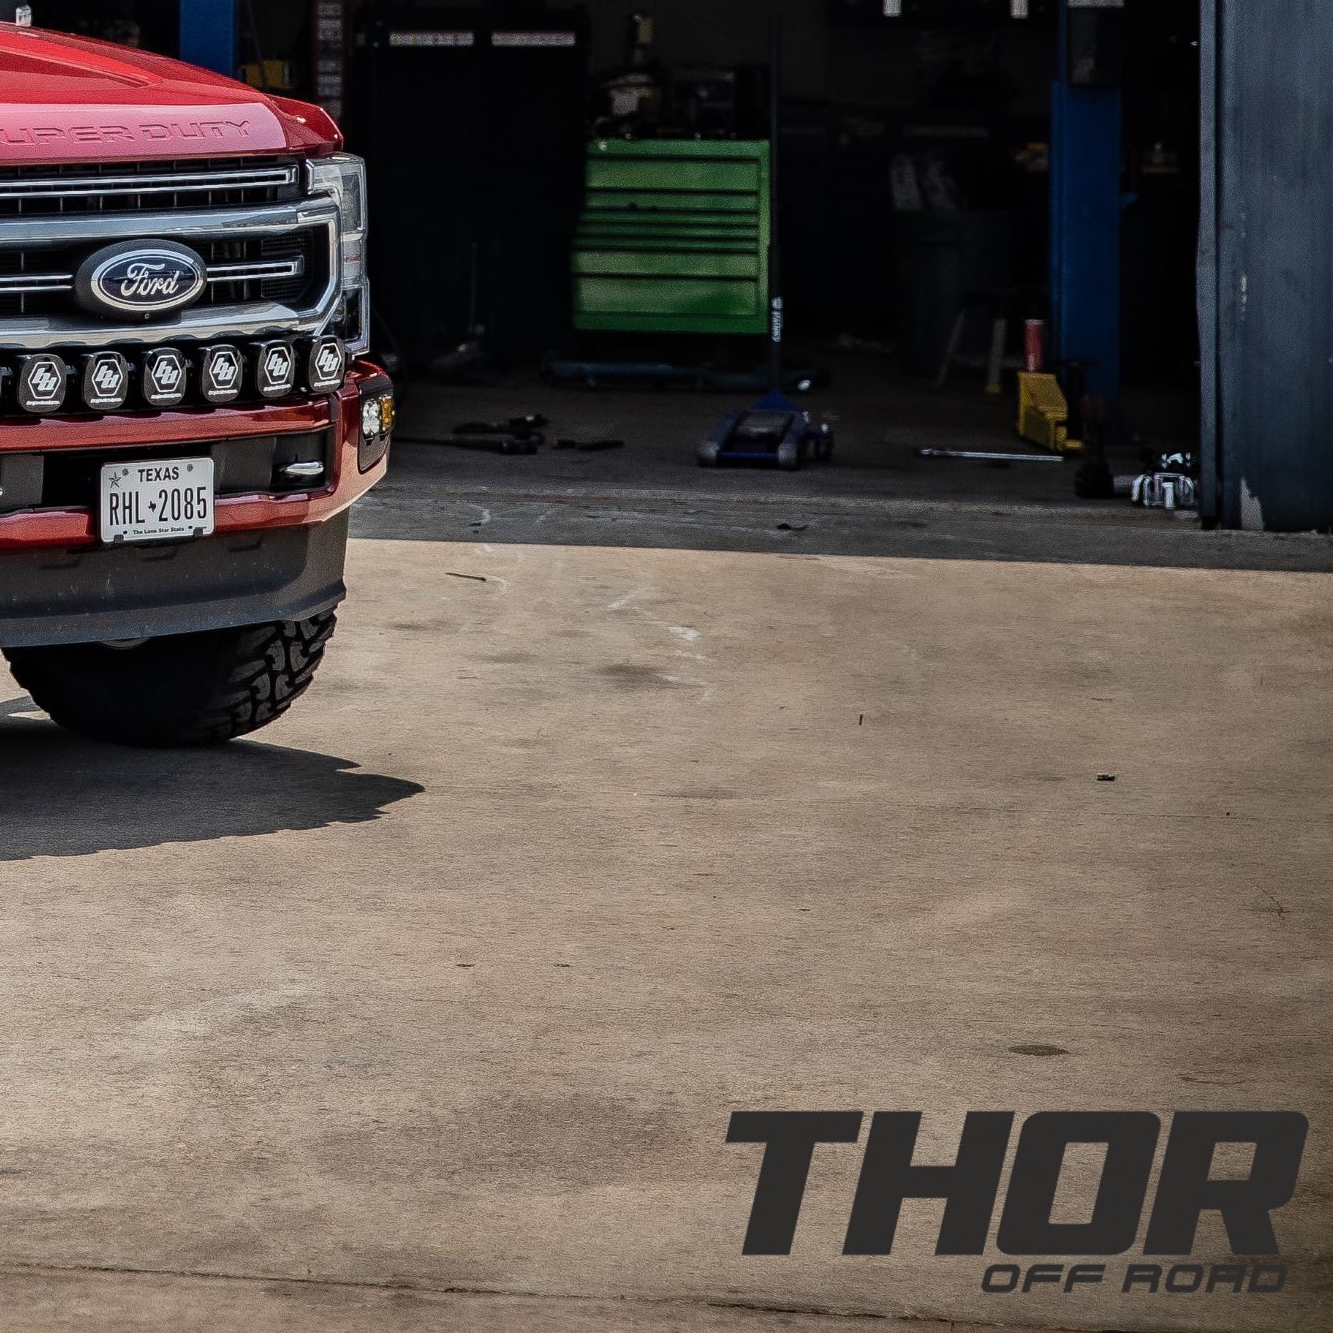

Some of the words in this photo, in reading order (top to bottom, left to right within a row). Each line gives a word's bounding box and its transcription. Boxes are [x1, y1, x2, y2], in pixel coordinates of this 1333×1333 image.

[139, 120, 251, 142] DUTY
[120, 262, 181, 297] Ford
[138, 467, 179, 482] TEXAS
[110, 491, 145, 525] RHL
[158, 486, 207, 522] 2085
